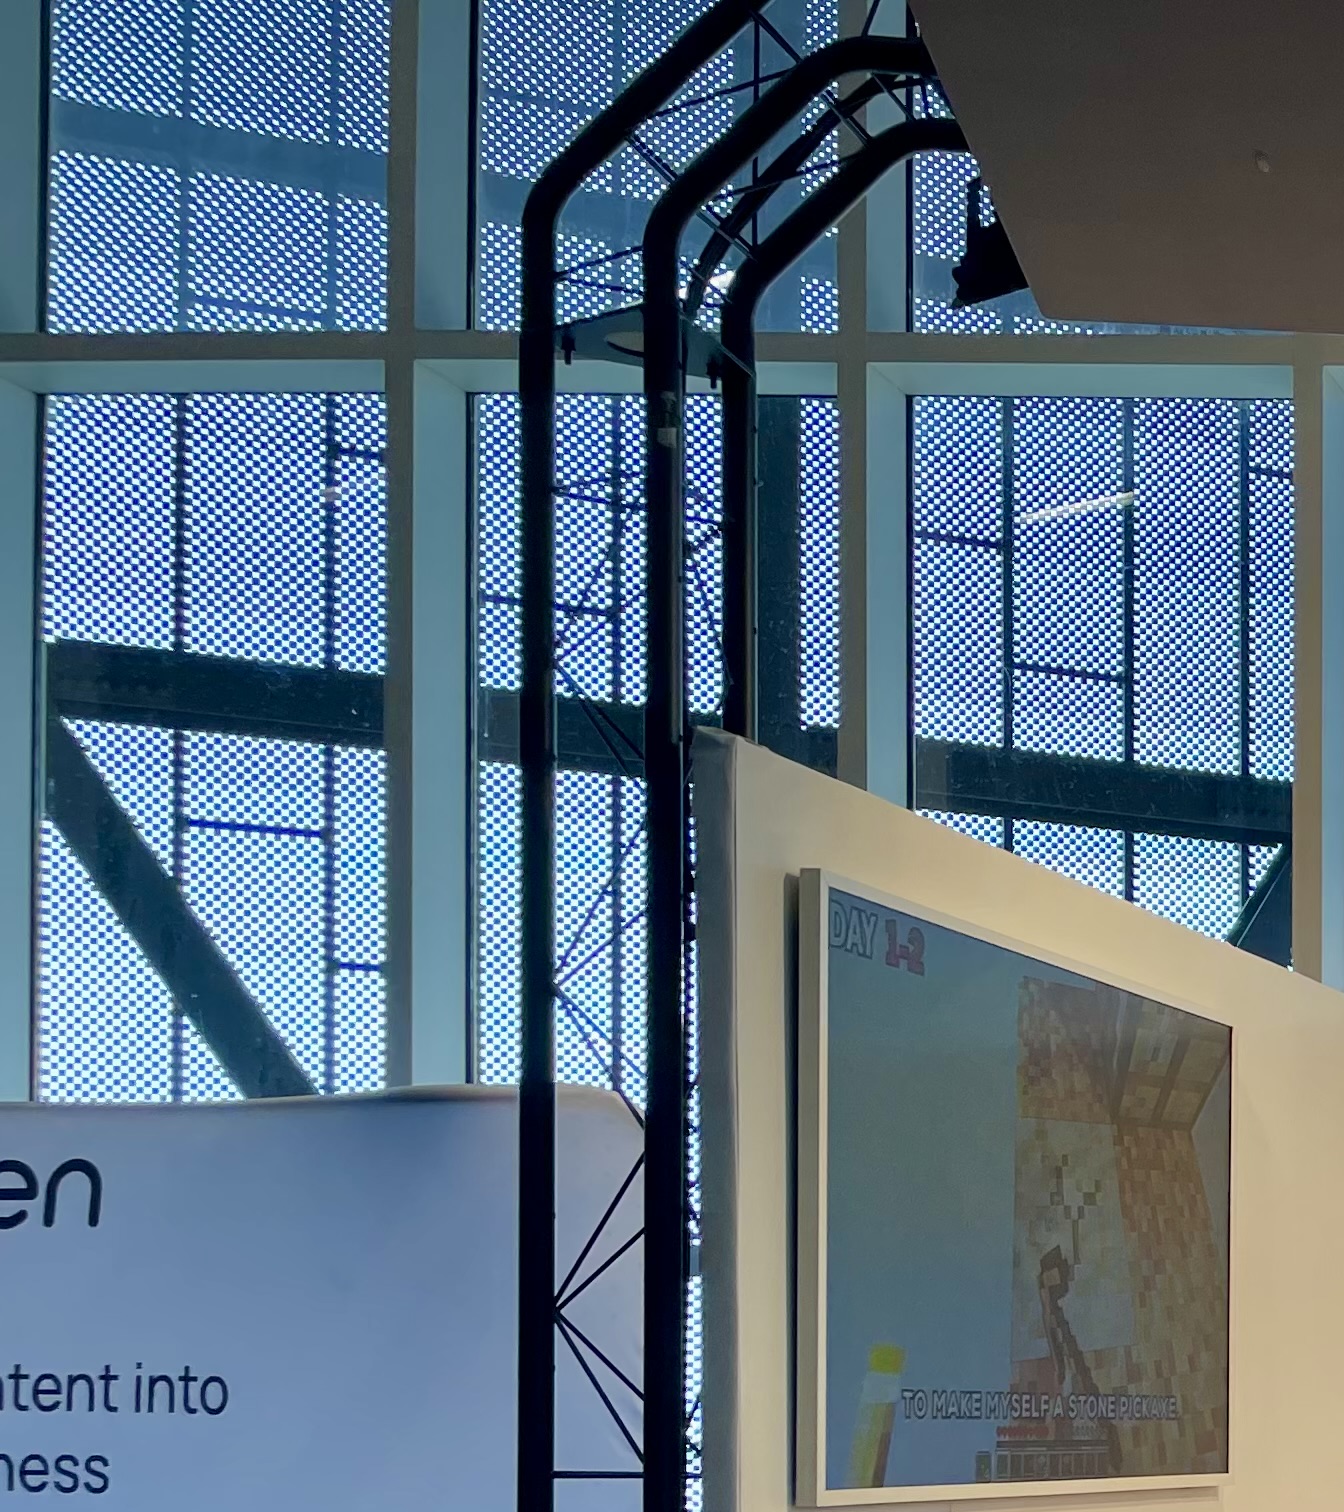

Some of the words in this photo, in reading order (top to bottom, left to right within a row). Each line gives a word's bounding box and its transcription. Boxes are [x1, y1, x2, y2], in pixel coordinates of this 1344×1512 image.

[828, 899, 878, 960] DAY
[0, 1363, 120, 1413] tent
[134, 1362, 229, 1415] into
[901, 1388, 928, 1420] TO
[931, 1389, 982, 1420] MAKE
[985, 1391, 1050, 1420] MYSELF
[1052, 1392, 1065, 1419] A
[1067, 1393, 1117, 1420] STONE
